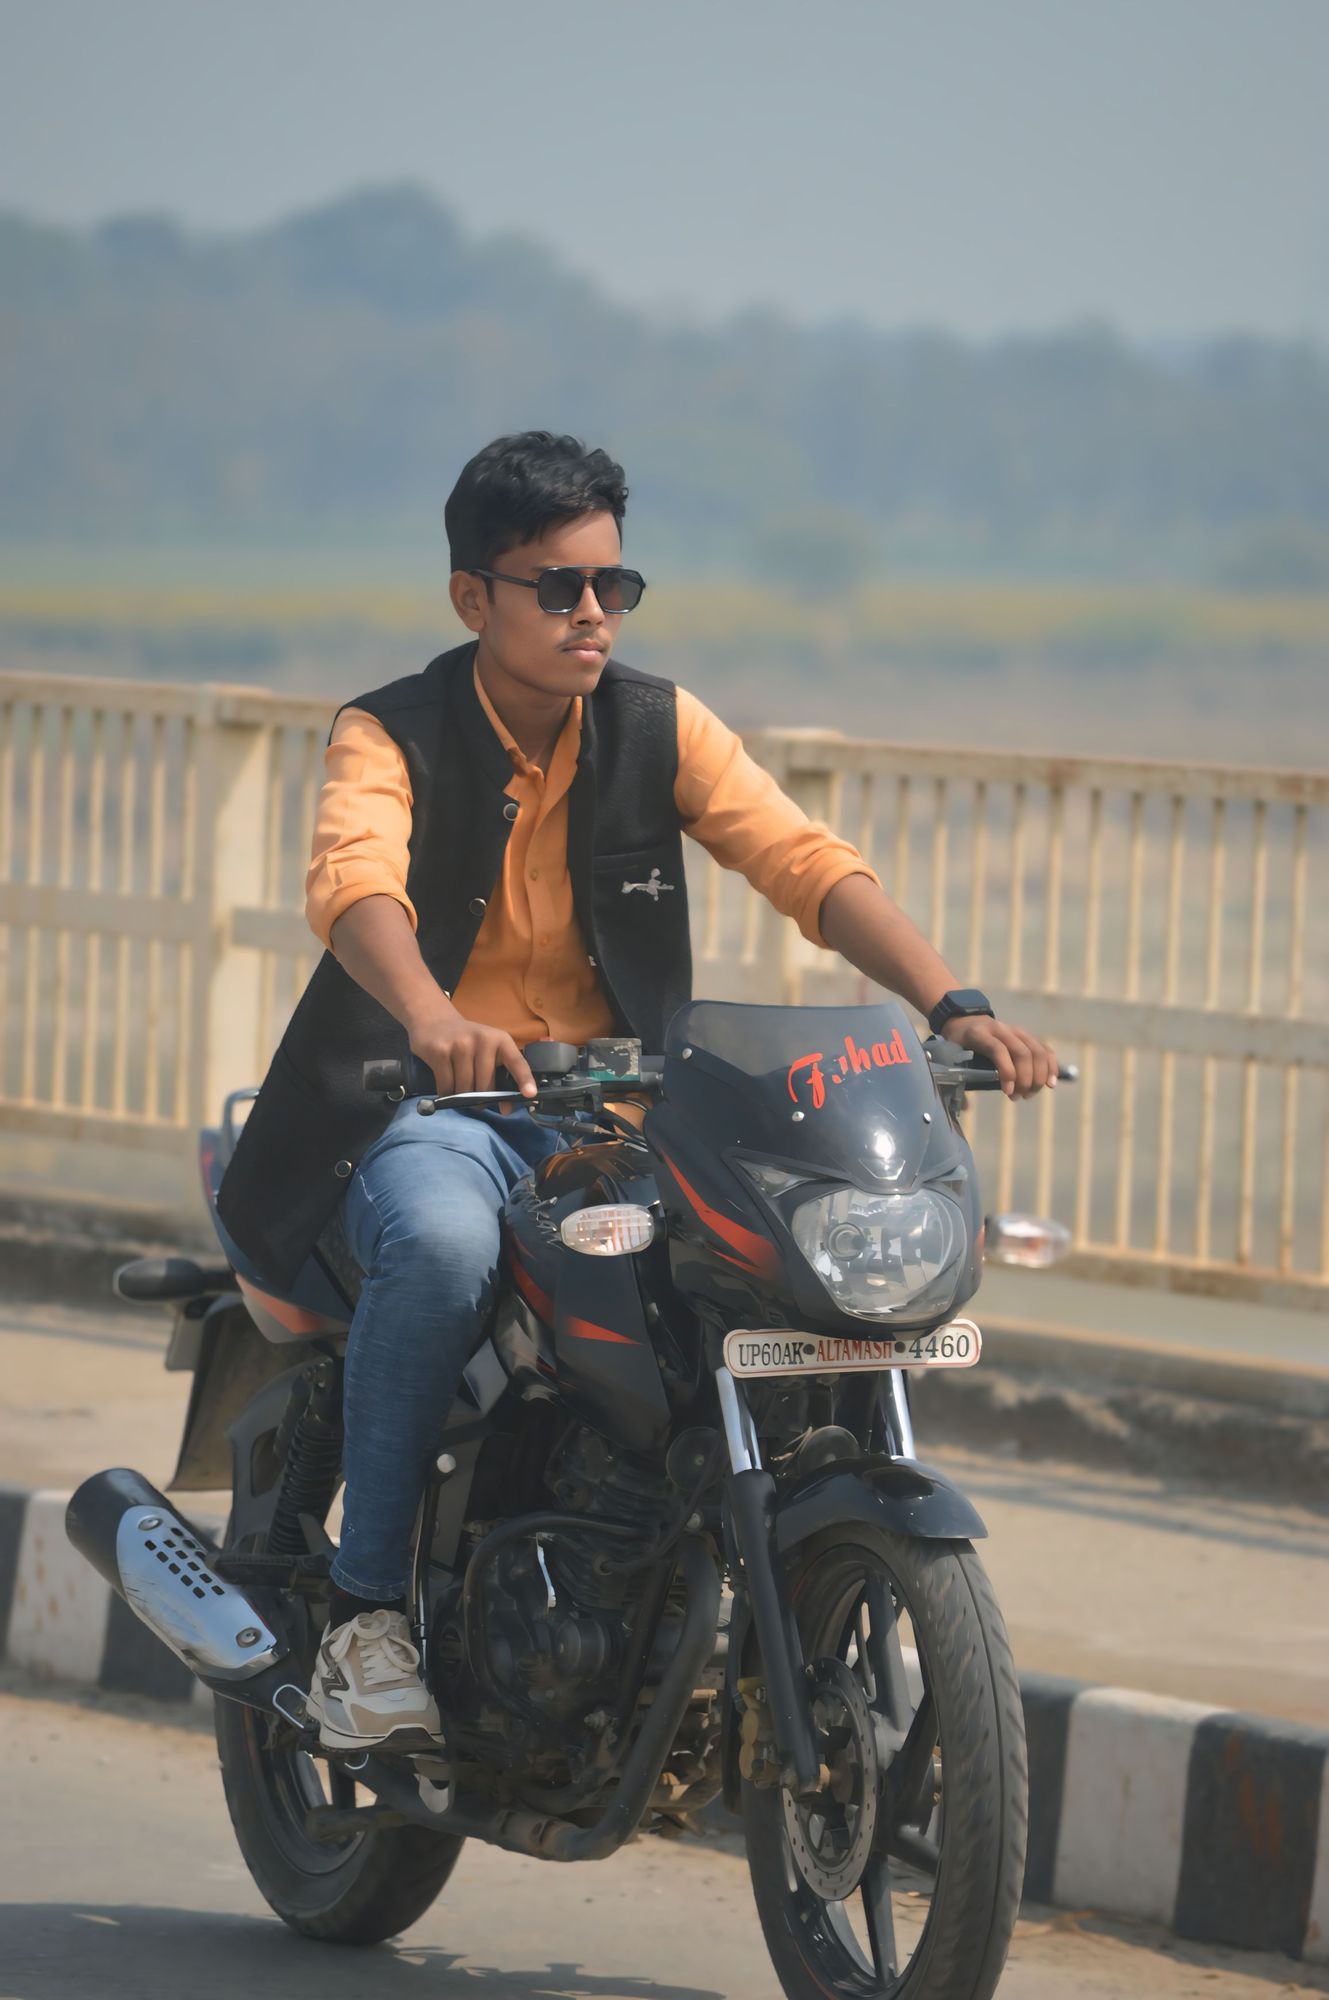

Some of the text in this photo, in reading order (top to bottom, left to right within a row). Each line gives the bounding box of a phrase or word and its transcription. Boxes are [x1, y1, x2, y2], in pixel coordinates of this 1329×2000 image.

[738, 1334, 970, 1367] UP60AK ALTAMASH 4460
